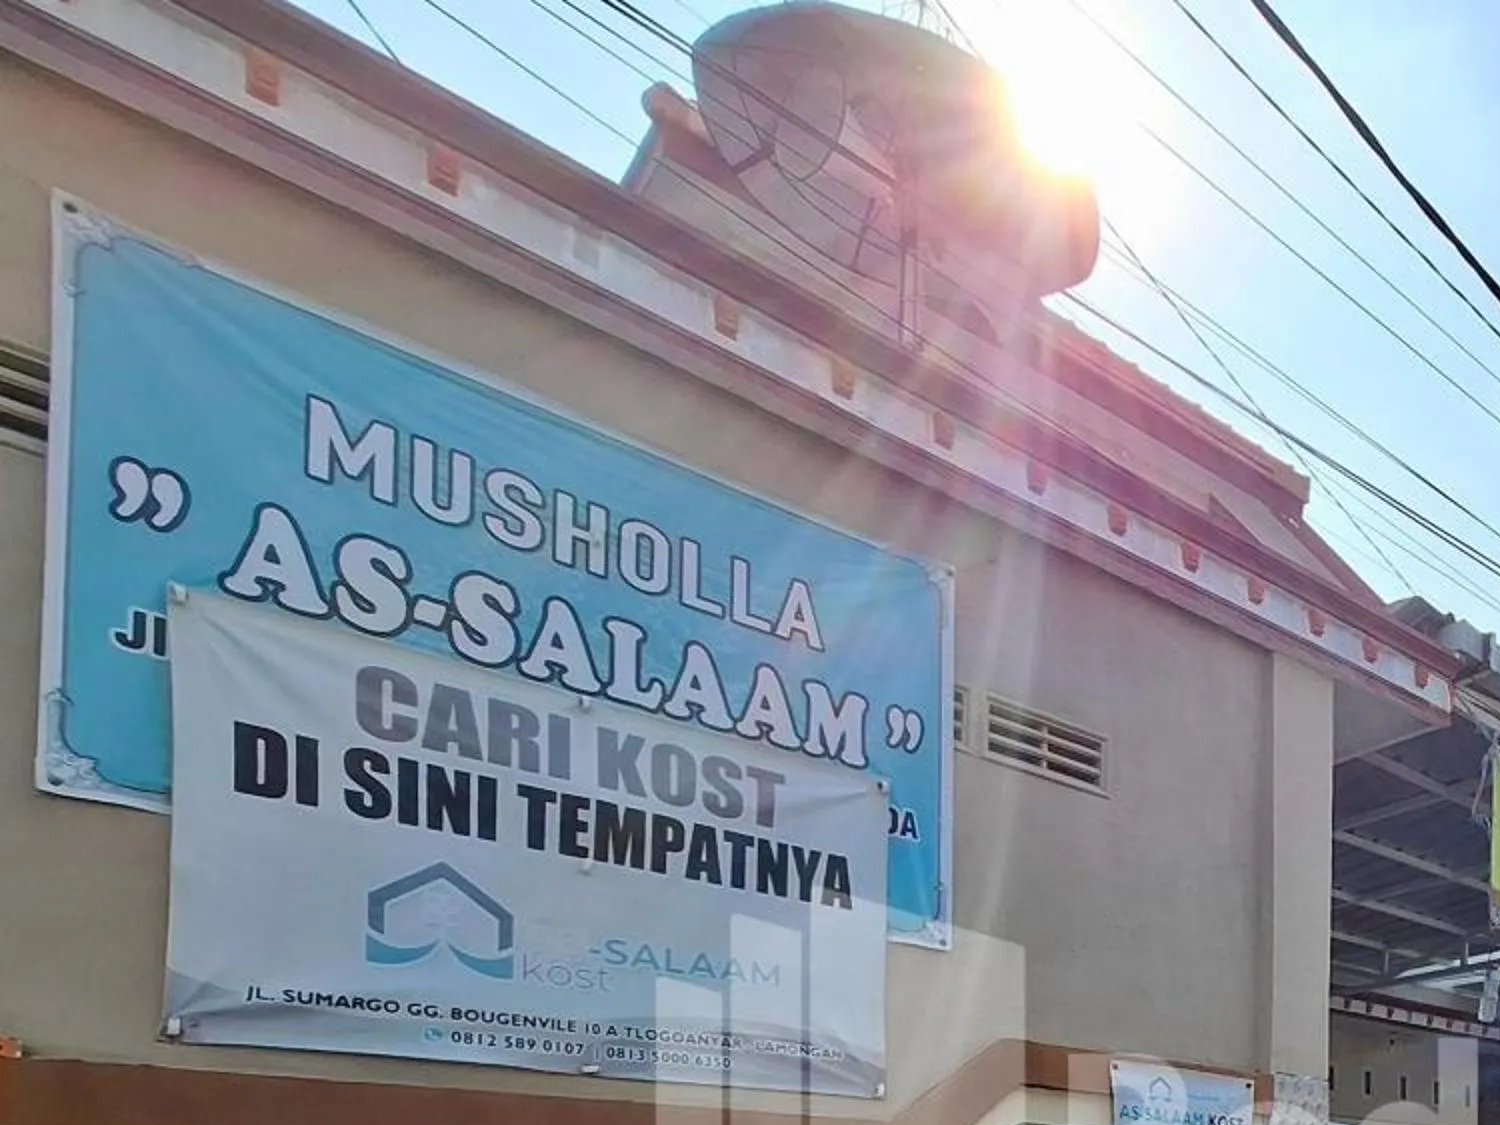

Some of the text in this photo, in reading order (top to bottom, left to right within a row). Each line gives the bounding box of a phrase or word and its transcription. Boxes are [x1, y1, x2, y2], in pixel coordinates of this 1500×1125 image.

[303, 394, 825, 652] MUSHOLLA
[233, 720, 853, 910] DI SINI TEMPATNYA
[354, 664, 785, 828] CARI KOST
[247, 985, 274, 1001] JL.
[282, 989, 400, 1014] SUMARGO
[407, 1003, 444, 1018] GG.
[451, 1007, 577, 1033] BOUGENVILE
[451, 1031, 497, 1047] 0812
[504, 1036, 536, 1051] 589
[543, 1039, 584, 1055] 0107
[606, 1046, 645, 1061] 0813
